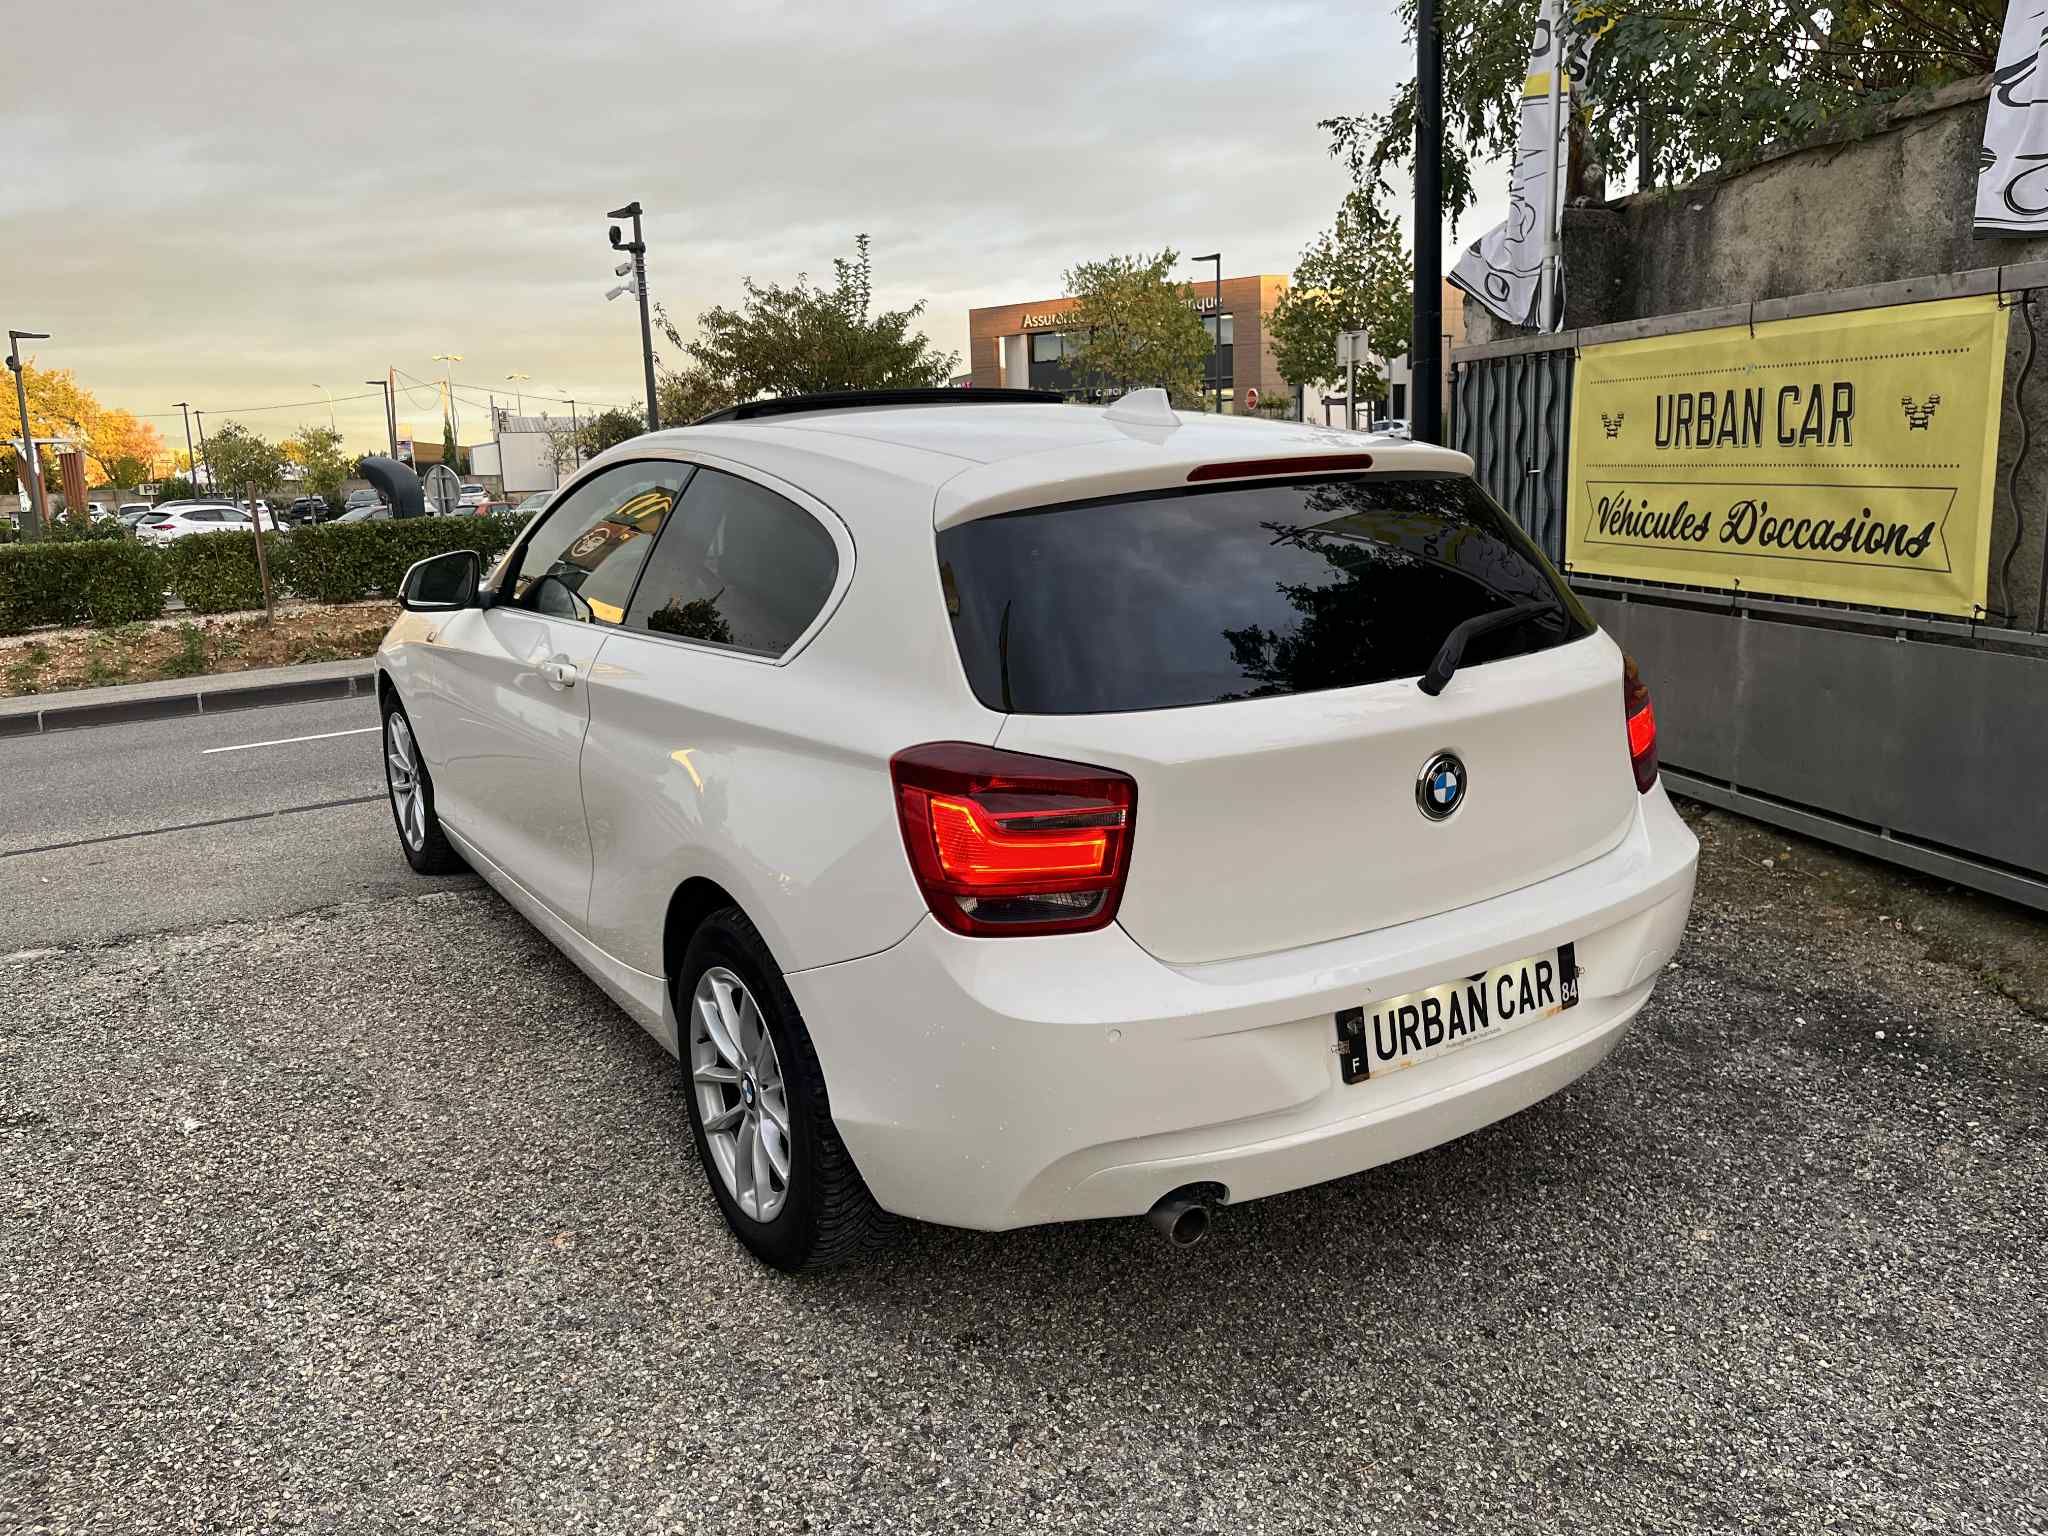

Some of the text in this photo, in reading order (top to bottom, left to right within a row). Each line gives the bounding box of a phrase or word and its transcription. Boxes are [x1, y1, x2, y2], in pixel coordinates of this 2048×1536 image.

[1178, 295, 1224, 312] anque
[1654, 380, 1856, 450] URBAN CAR
[1597, 490, 1937, 559] Véhicules D'occasions
[1373, 960, 1555, 1061] URBAN CAR
[1562, 978, 1577, 1001] 84
[1352, 1057, 1360, 1073] F
